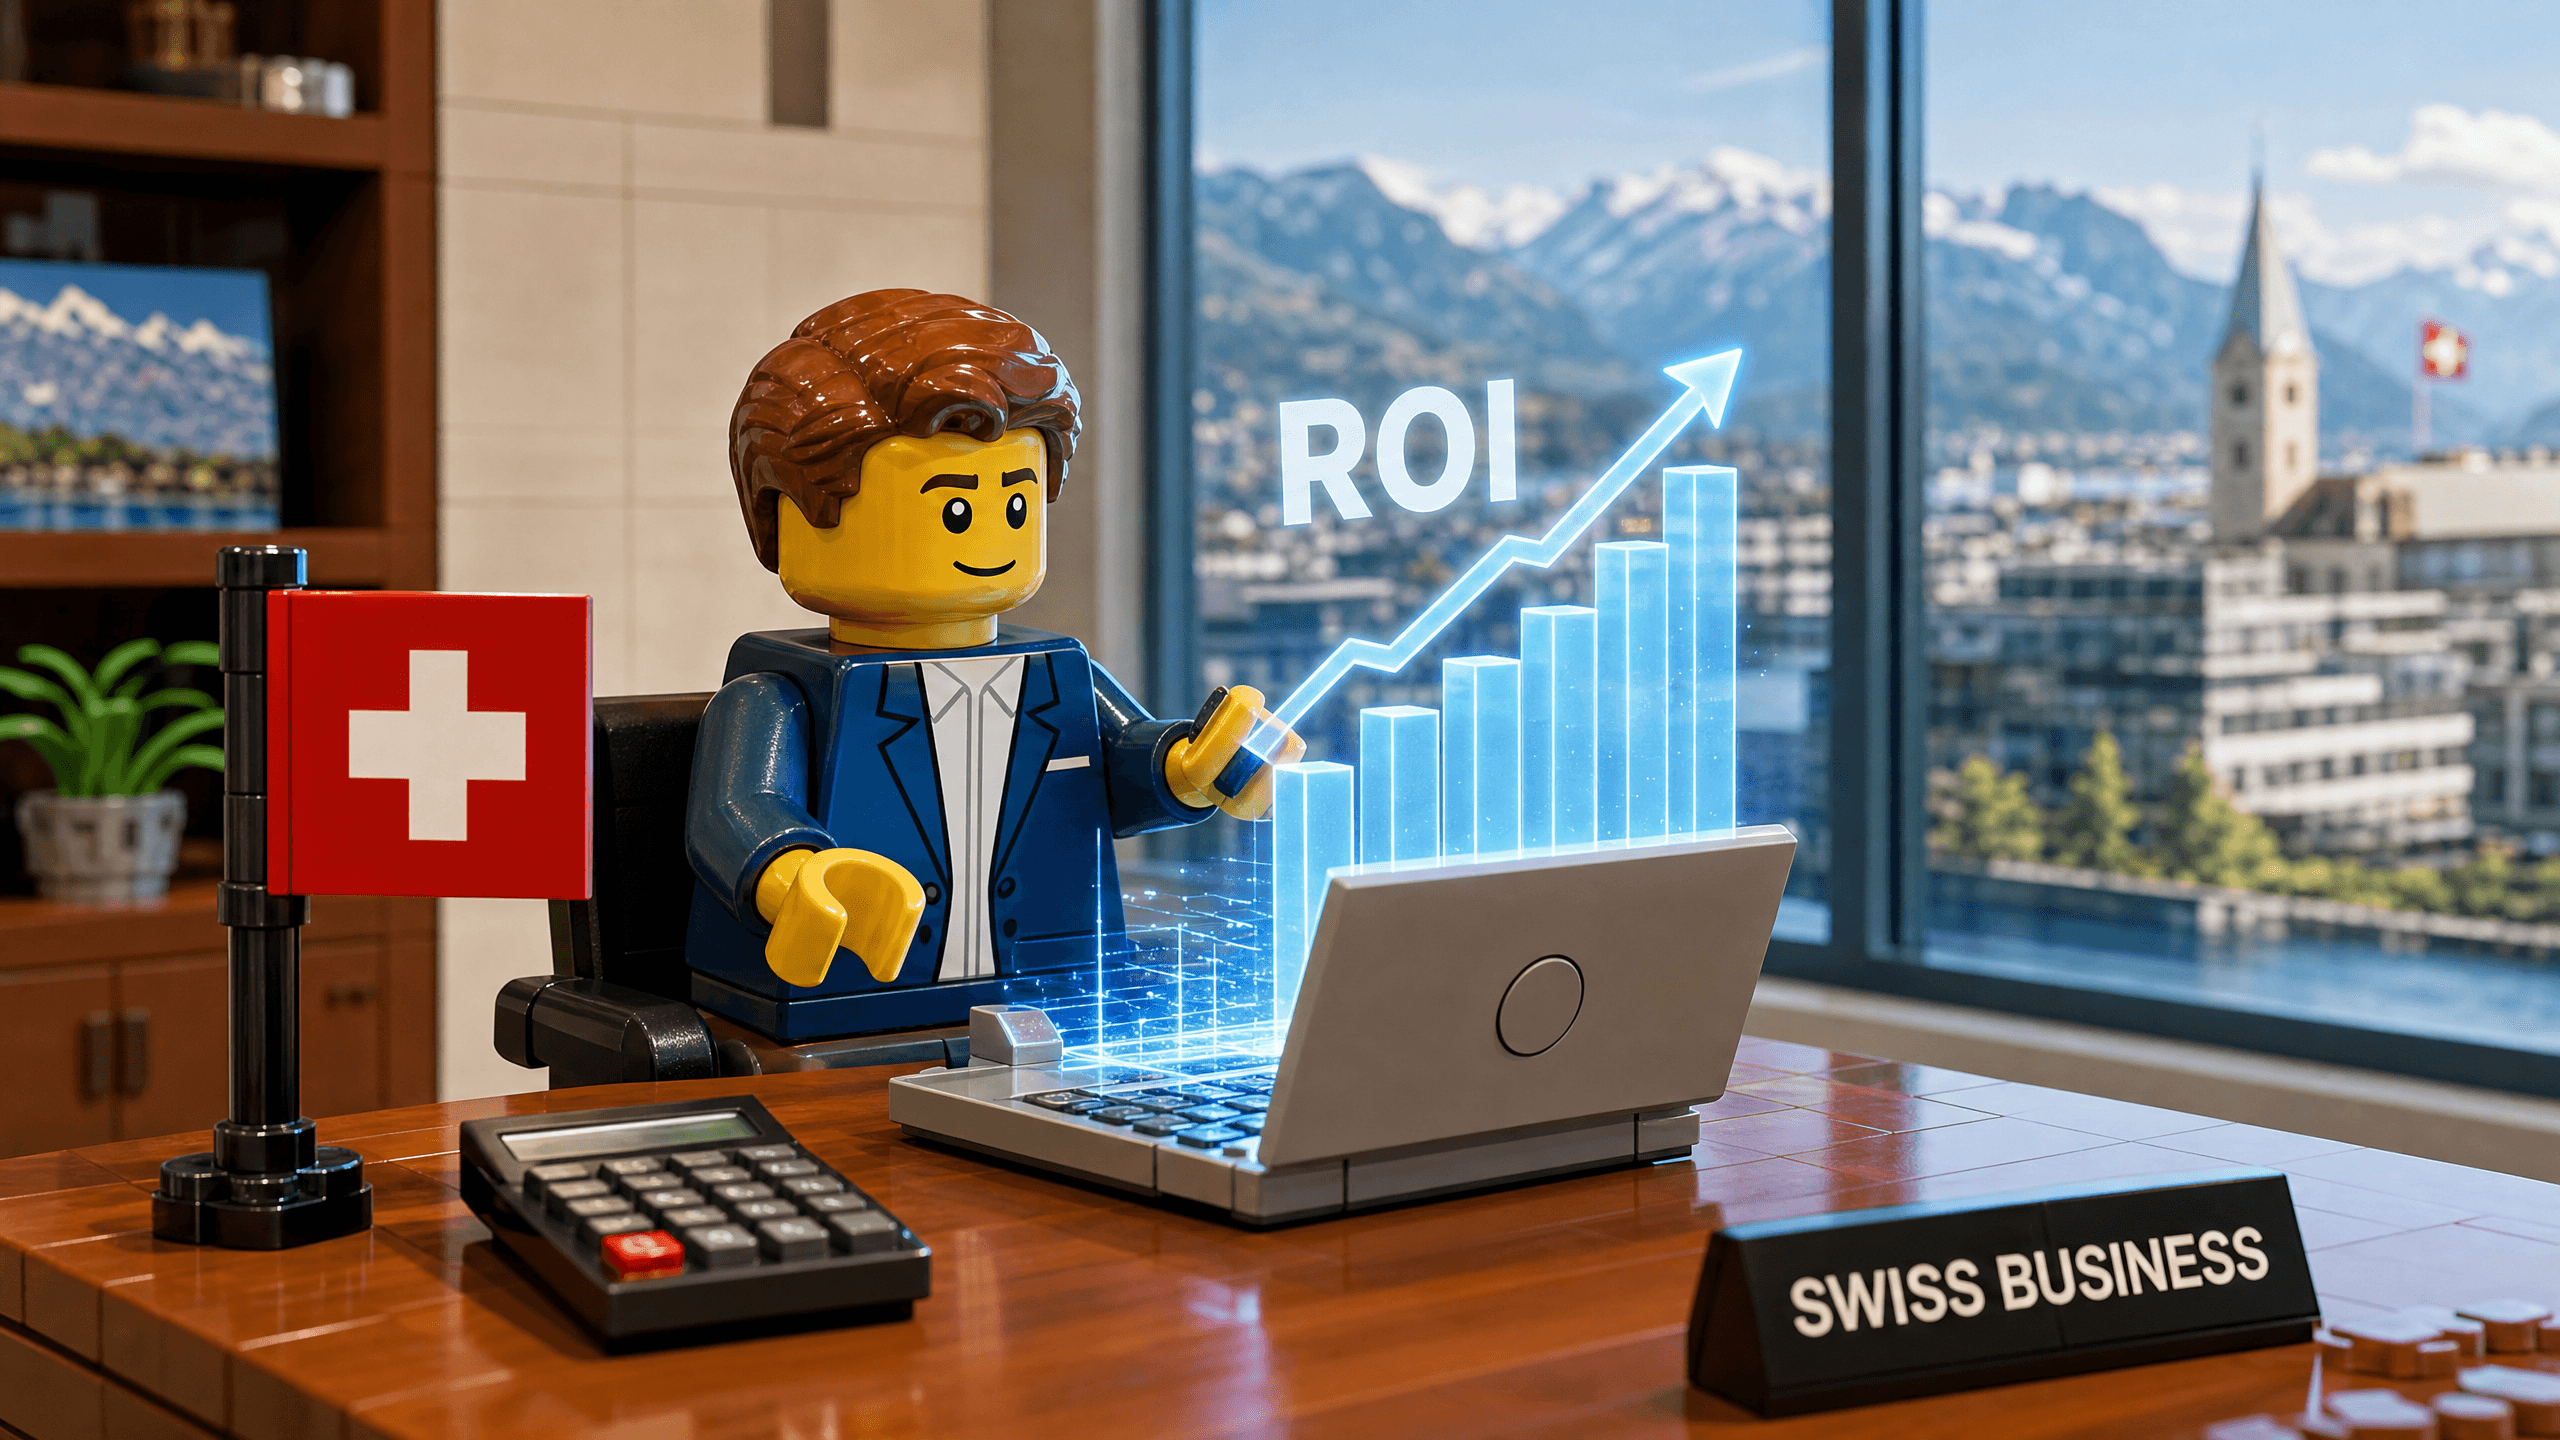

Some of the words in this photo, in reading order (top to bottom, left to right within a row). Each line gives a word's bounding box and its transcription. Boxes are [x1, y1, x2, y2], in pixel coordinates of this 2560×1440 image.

[1279, 378, 1517, 526] ROI
[1790, 1258, 1986, 1339] SWISS
[1995, 1226, 2270, 1312] BUSINESS
